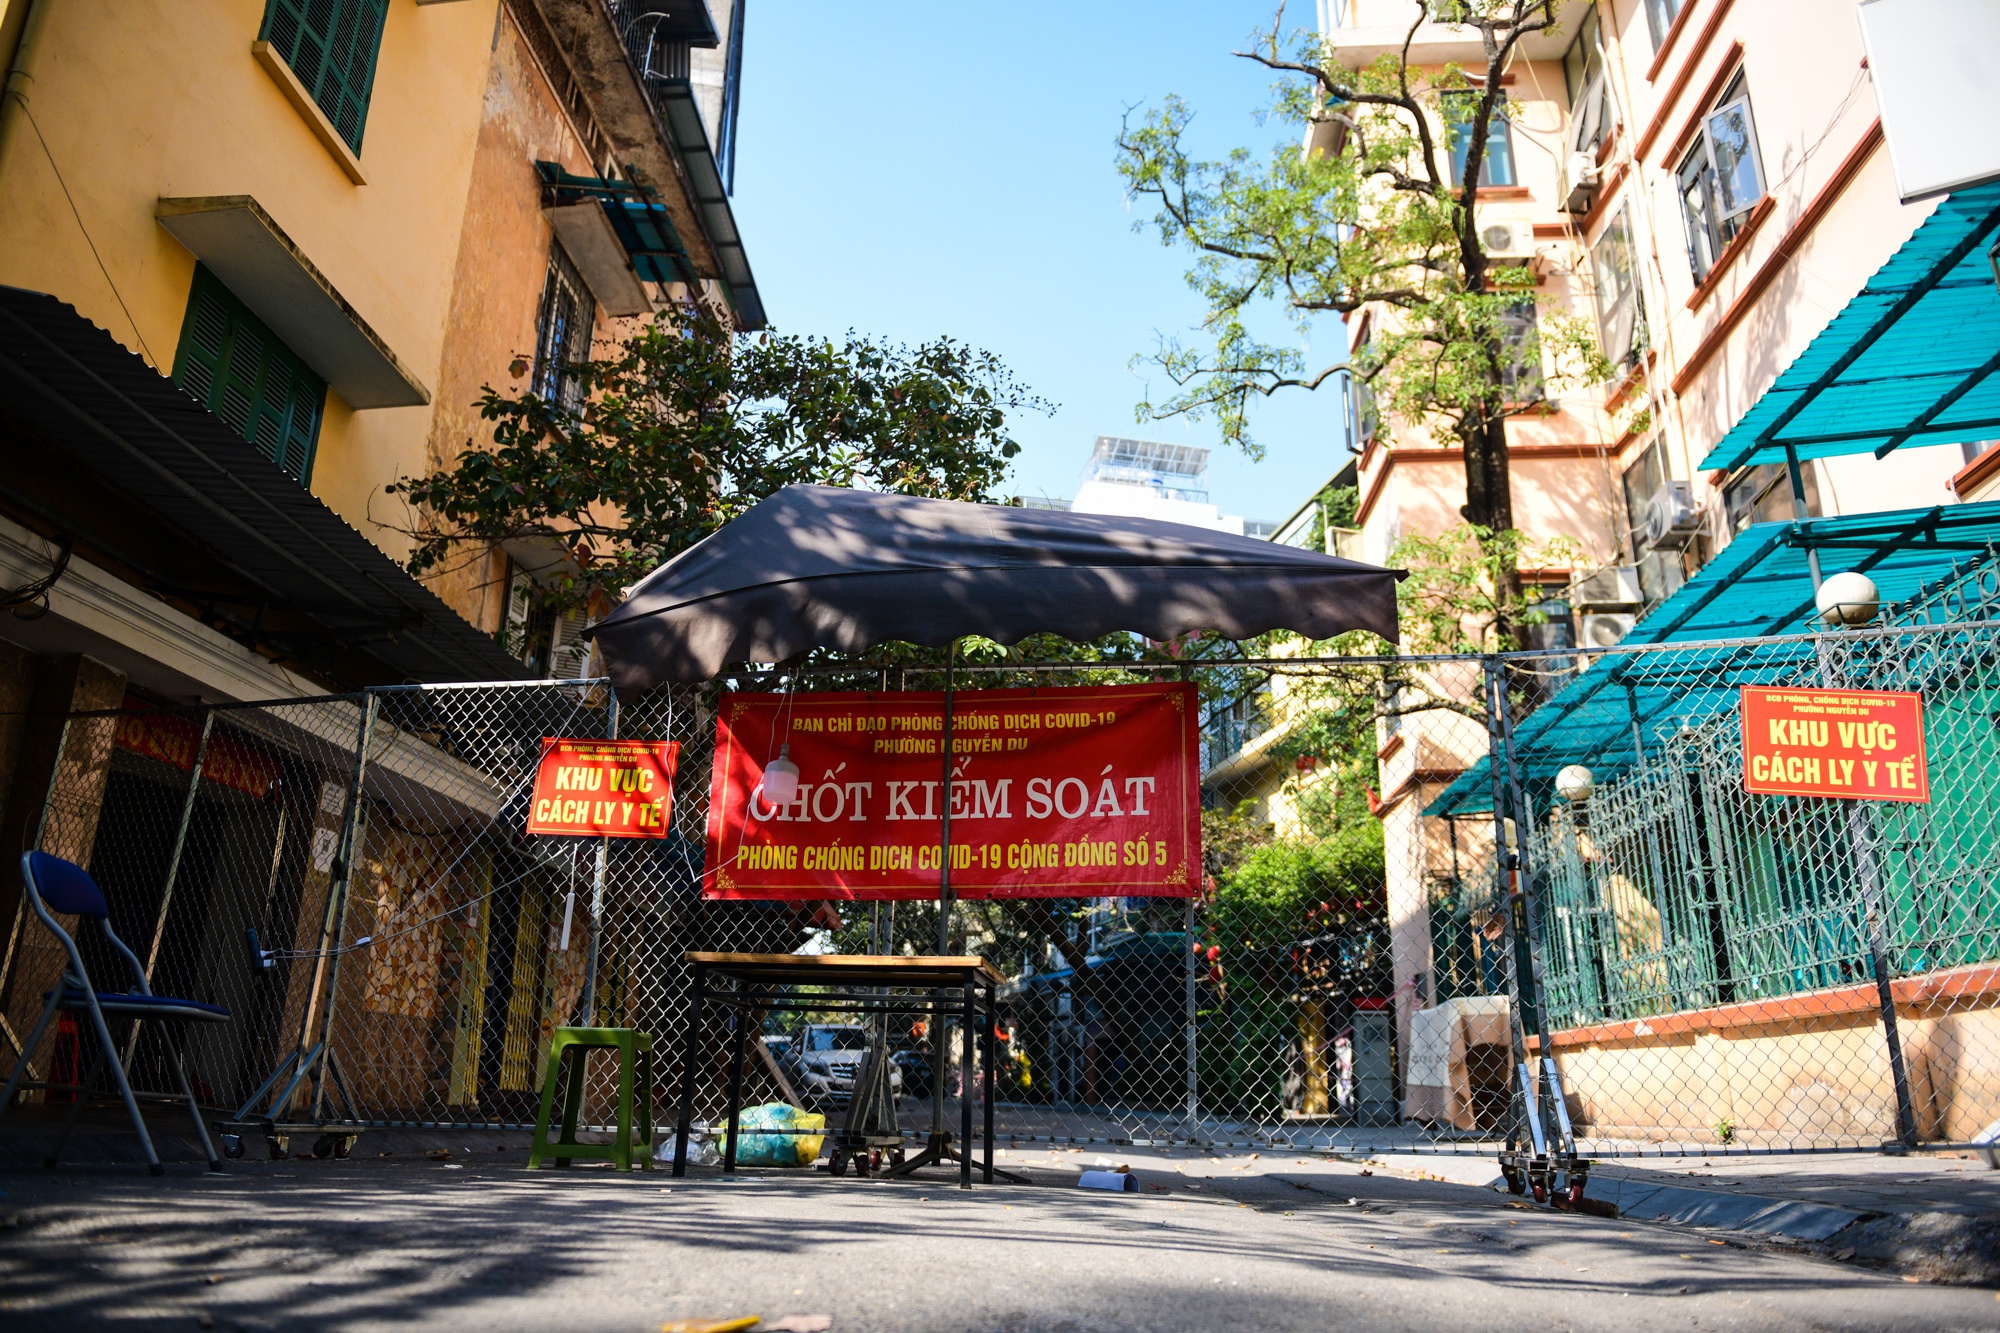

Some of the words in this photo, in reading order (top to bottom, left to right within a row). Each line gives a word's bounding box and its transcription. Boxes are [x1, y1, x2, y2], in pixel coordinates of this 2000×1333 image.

[1861, 698, 1896, 707] COVID-19
[792, 717, 823, 732] BAN
[828, 712, 852, 732] CHỈ
[856, 716, 887, 734] ĐẠO
[890, 713, 943, 731] PHÒNG
[951, 710, 1000, 730] CHỐNG
[1004, 713, 1041, 732] DỊCH
[1045, 711, 1116, 729] COVID-19
[1769, 718, 1829, 748] KHU
[1837, 720, 1896, 755] VỰC
[874, 735, 936, 754] PHƯỜNG
[1007, 737, 1028, 751] DU
[555, 766, 602, 791] KHU
[610, 767, 654, 798] VỰC
[1752, 751, 1820, 784] CÁCH
[1828, 759, 1855, 786] LY
[1862, 761, 1878, 787] Y
[1886, 754, 1916, 789] TẾ
[750, 762, 872, 822] CHỐT
[886, 756, 1012, 821] KIỂM
[1026, 764, 1155, 819] SOÁT
[536, 794, 590, 824] CÁCH
[593, 802, 616, 825] LY
[622, 802, 634, 826] Y
[639, 796, 666, 827] TẾ
[737, 839, 798, 870] PHÒNG
[803, 838, 864, 870] CHỐNG
[870, 845, 913, 876] DỊCH
[1008, 838, 1059, 874] CỘNG
[1064, 834, 1117, 867] ĐỒNG
[1123, 832, 1150, 866] SỐ
[1155, 841, 1167, 866] 5
